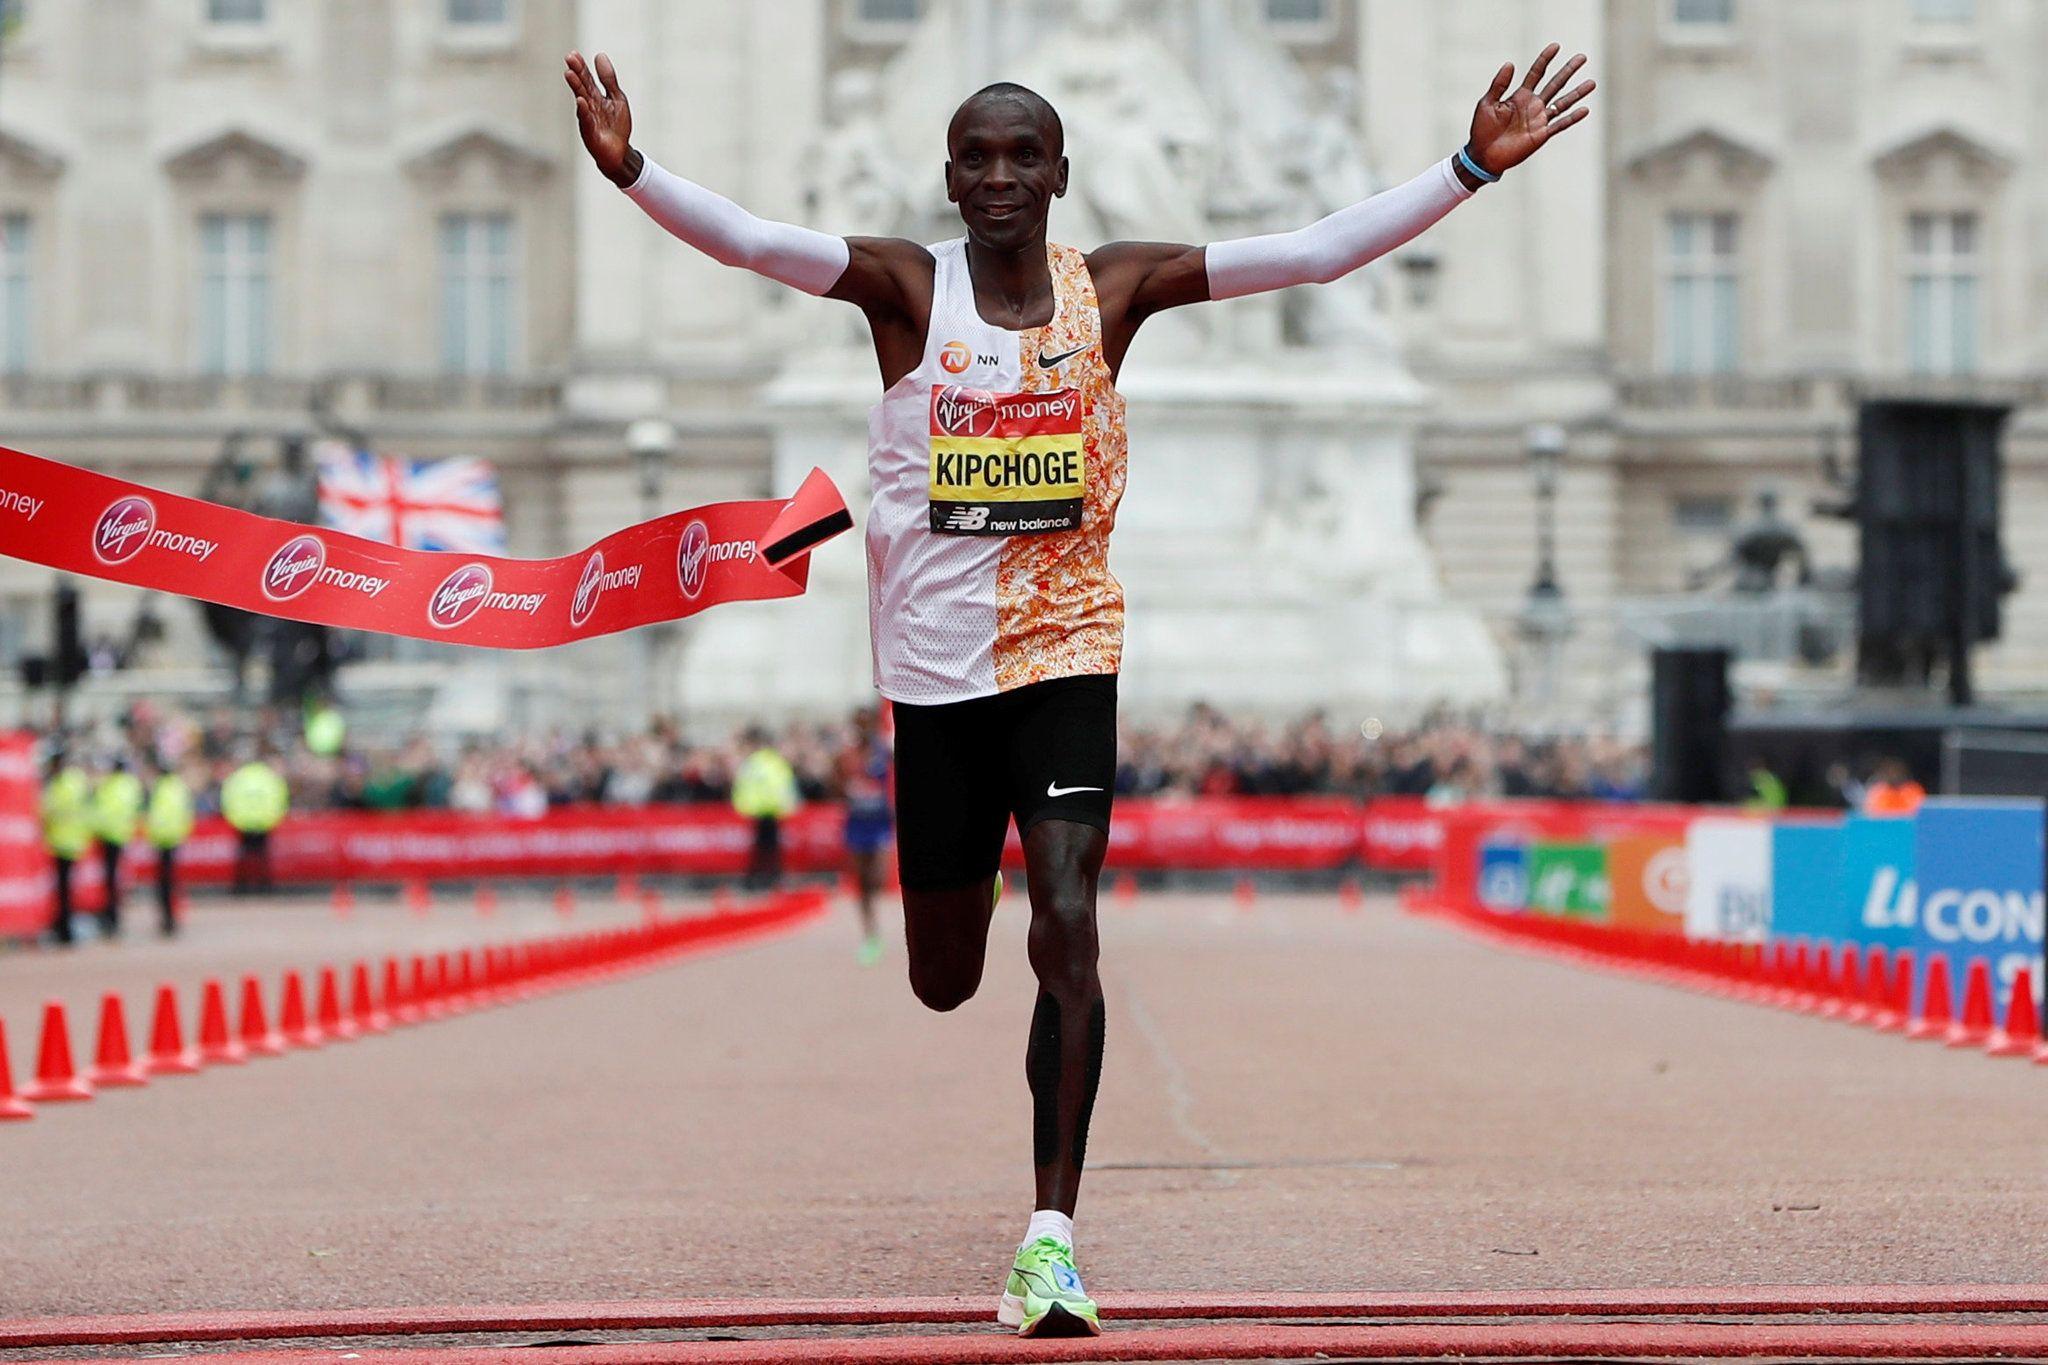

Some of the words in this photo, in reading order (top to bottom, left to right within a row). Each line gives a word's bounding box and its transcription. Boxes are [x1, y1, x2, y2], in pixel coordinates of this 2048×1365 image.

[977, 354, 999, 366] NN
[1001, 399, 1075, 421] money
[936, 451, 1079, 487] KIPCHOGE
[101, 504, 149, 555] Virgin
[149, 529, 219, 562] money
[990, 520, 1017, 531] new
[1019, 517, 1069, 530] balance
[708, 540, 757, 564] money
[270, 543, 319, 591] Virgin
[319, 566, 391, 598] money
[601, 564, 643, 592] money
[437, 572, 485, 618] Virgin
[484, 592, 547, 616] money
